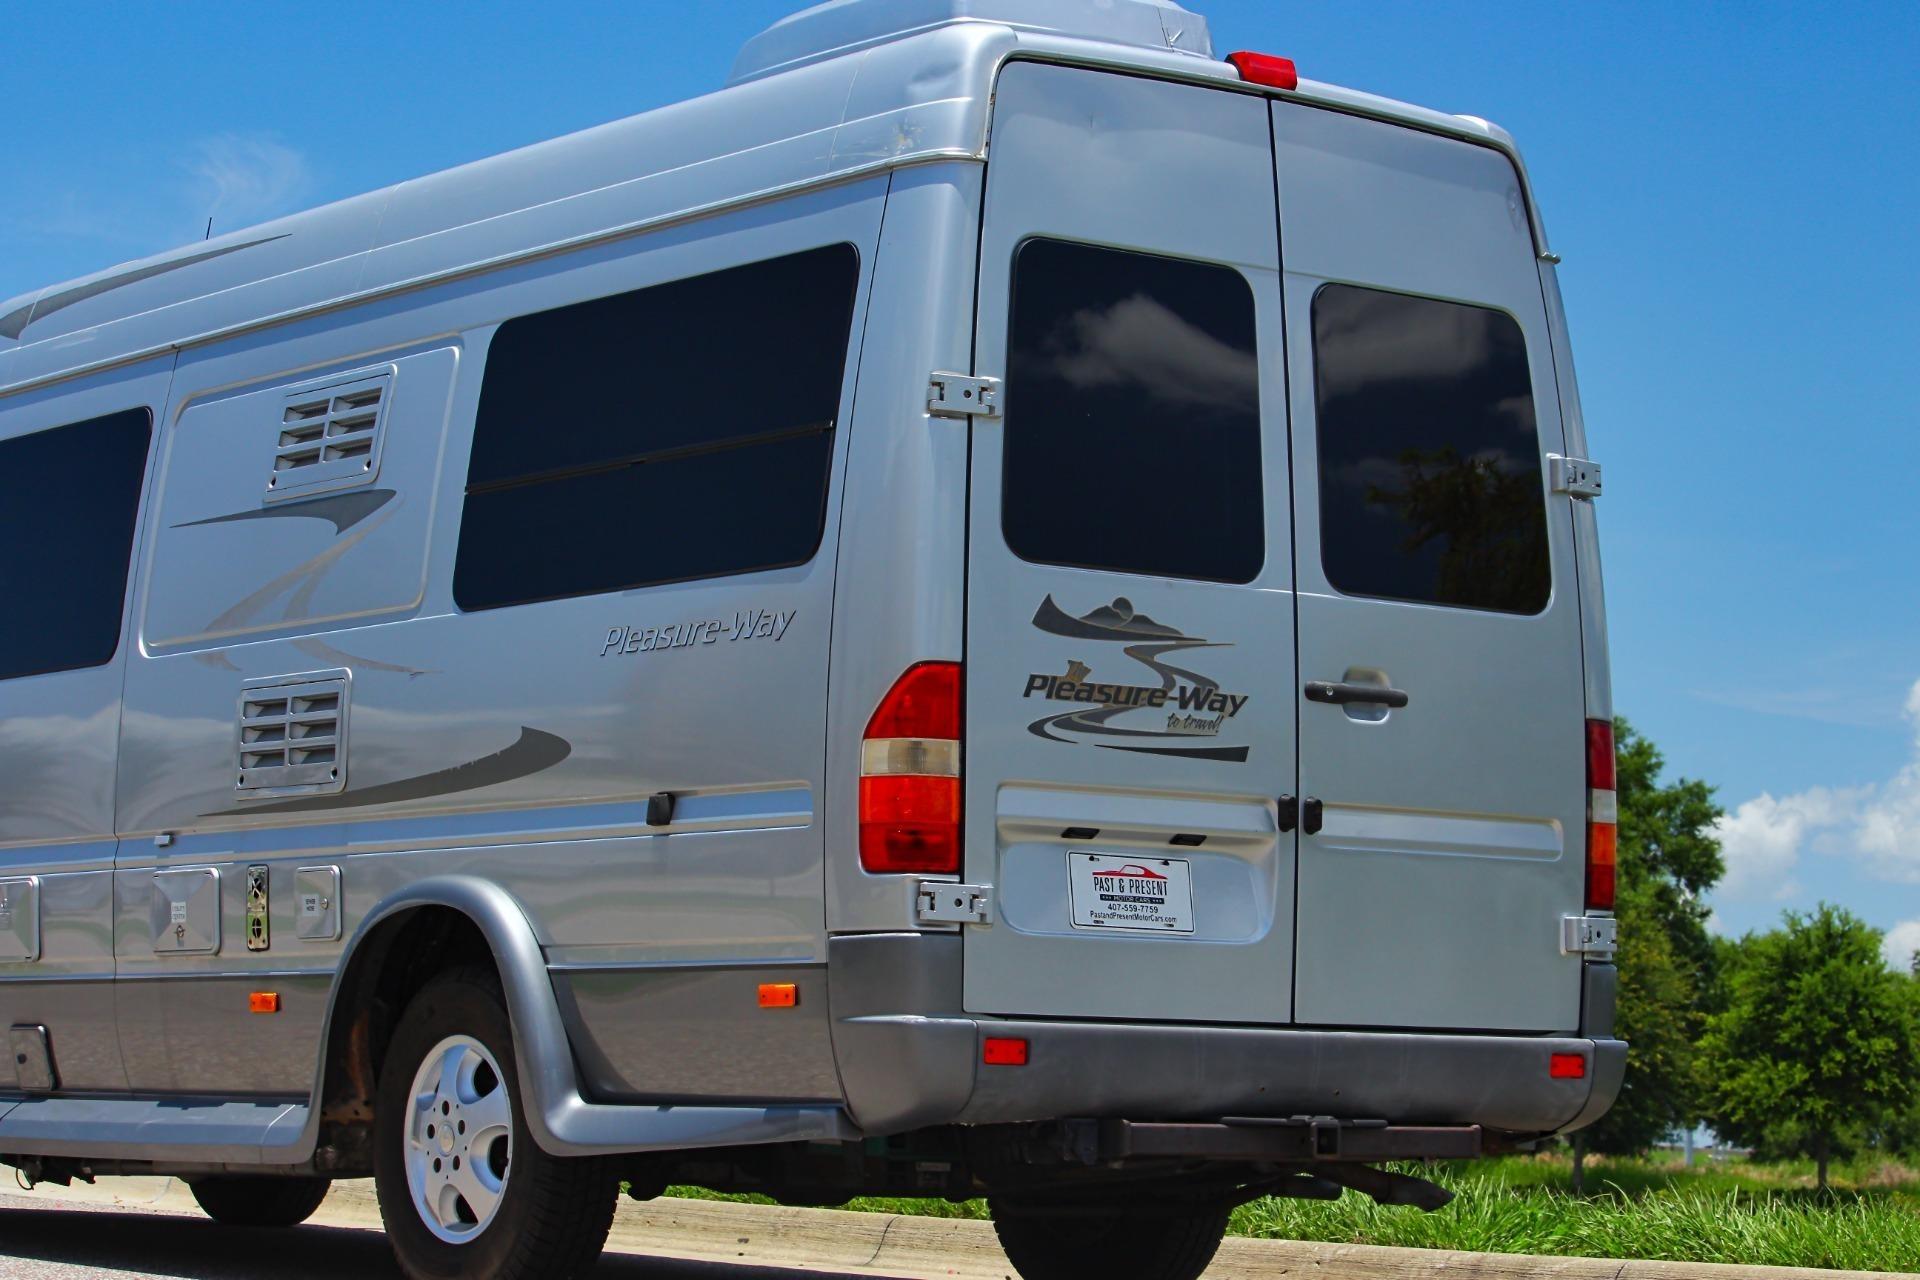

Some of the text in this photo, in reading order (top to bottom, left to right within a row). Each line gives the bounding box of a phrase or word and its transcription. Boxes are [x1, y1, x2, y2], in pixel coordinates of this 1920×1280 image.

[600, 609, 797, 656] Pleasure-Way
[1023, 673, 1249, 718] Pleasure-Way
[1167, 712, 1224, 734] to travel!
[1093, 876, 1168, 896] PAST & PRESENT
[1107, 903, 1159, 914] 407-559-7759
[1135, 896, 1151, 904] CARS
[1089, 910, 1177, 923] PastandPresentMotorCars.com
